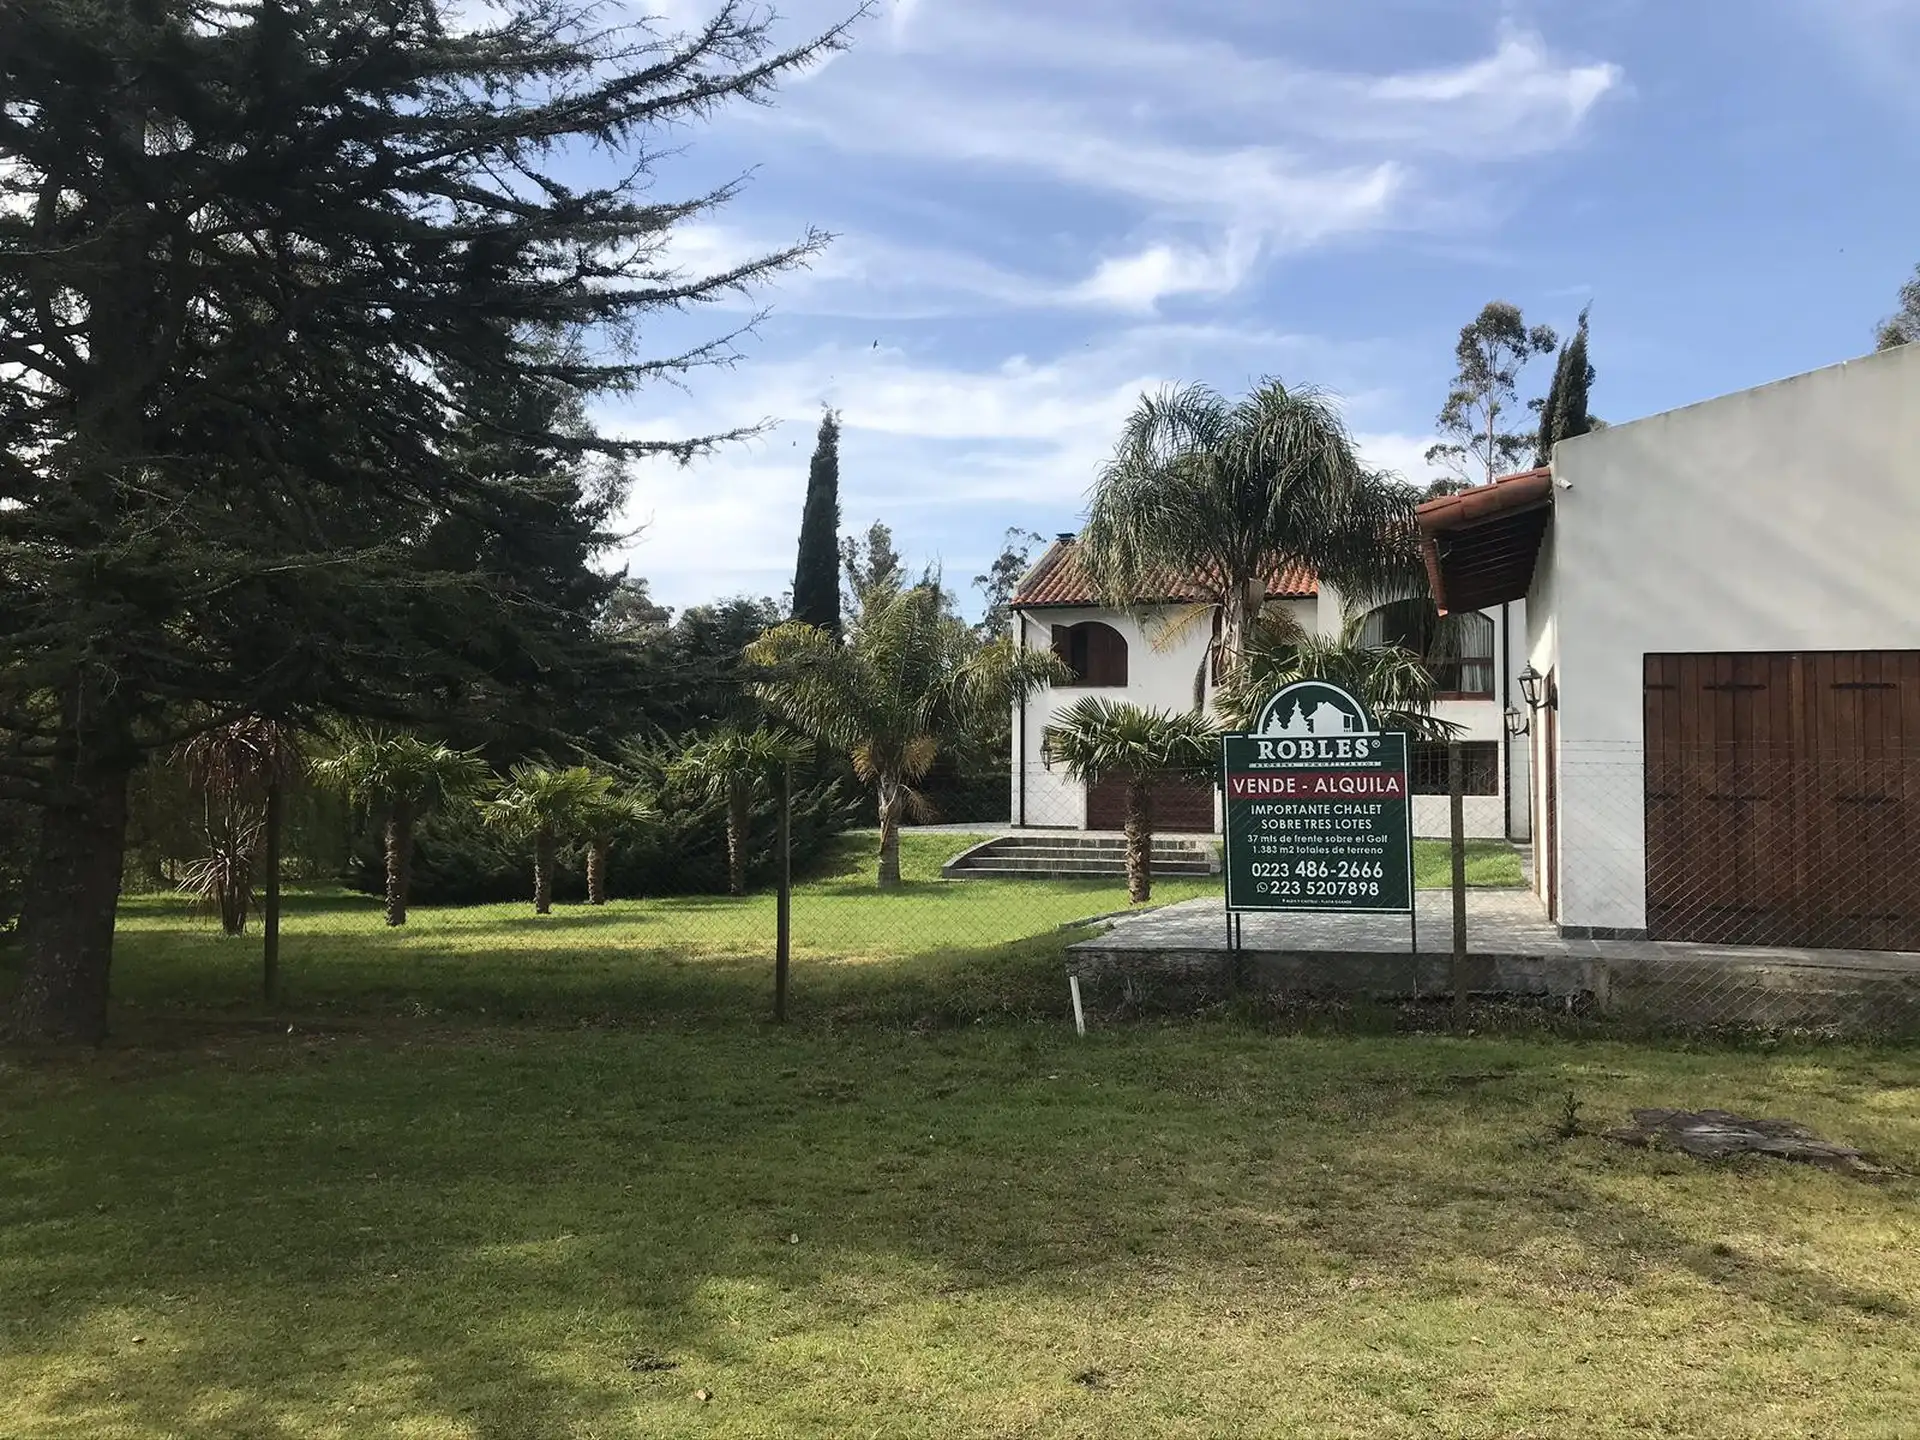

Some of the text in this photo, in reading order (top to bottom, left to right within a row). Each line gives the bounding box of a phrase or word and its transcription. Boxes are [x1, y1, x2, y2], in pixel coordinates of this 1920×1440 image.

[1233, 777, 1296, 794] VENDE
[1314, 777, 1400, 794] ALQUILA
[1250, 804, 1382, 815] IMPORTANTE CHALET
[1261, 819, 1372, 829] SOBRE TRES LOTES
[1247, 834, 1388, 844] 37 mts de frente sobre el Golf
[1252, 845, 1384, 855] 1.383 m2 totales de terreno
[1251, 860, 1384, 879] 0223 486-2666
[1270, 880, 1380, 896] 223 5207898
